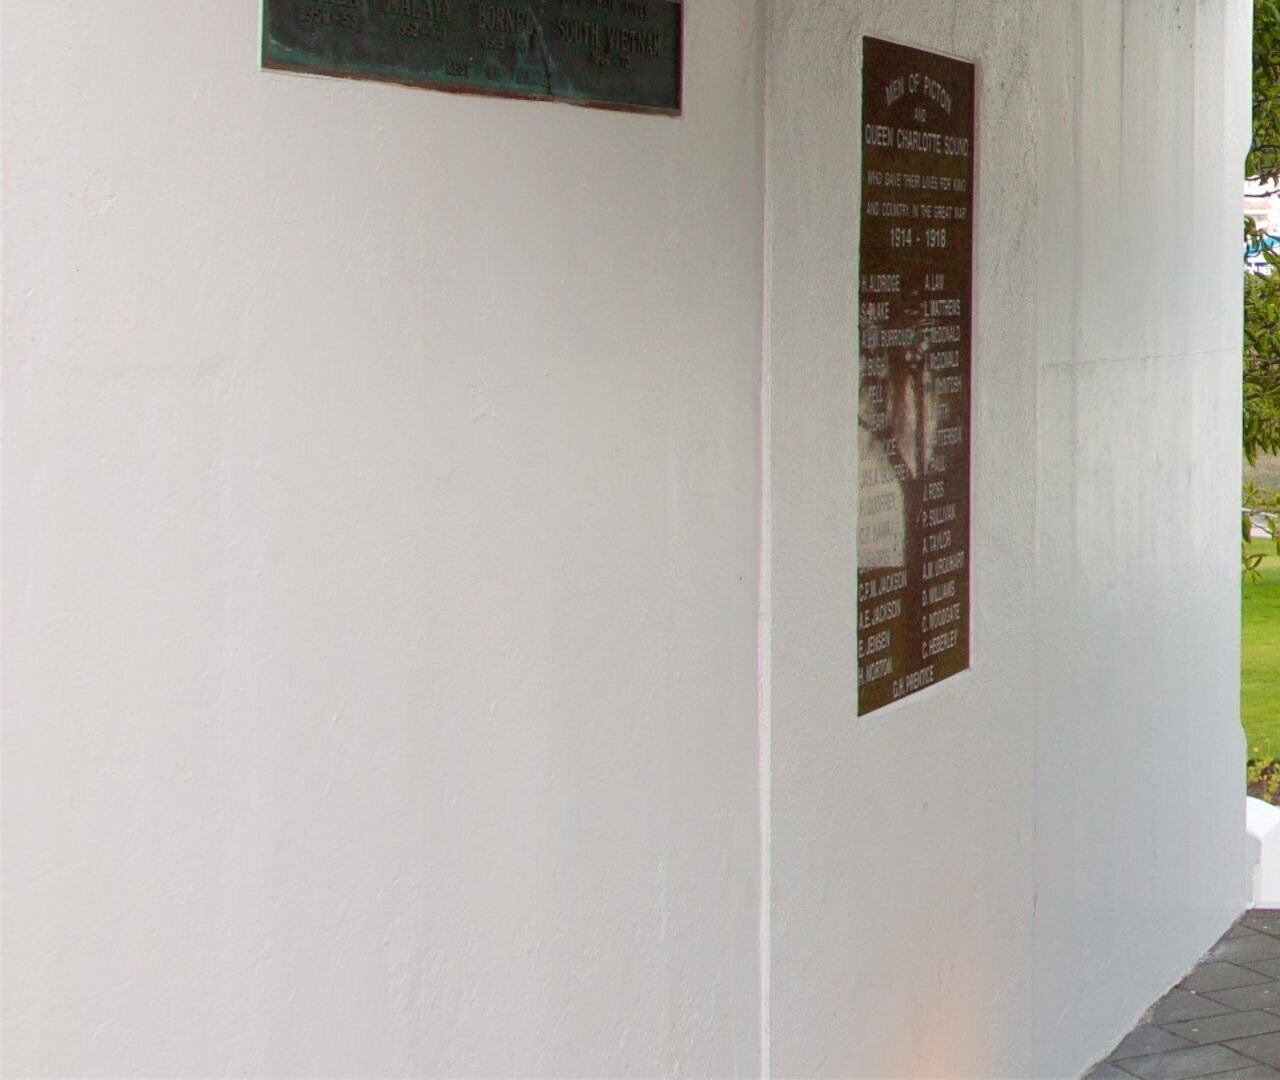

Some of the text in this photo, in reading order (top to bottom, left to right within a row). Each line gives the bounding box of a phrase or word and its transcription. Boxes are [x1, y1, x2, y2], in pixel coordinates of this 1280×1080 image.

[556, 17, 664, 58] SOUTH VIETNAM
[885, 73, 952, 116] MEN OF PICTON
[914, 107, 927, 122] AND
[865, 123, 969, 157] QUEEN CHARLOTTE SOUND
[867, 170, 966, 192] WHO GAVE THEIR LIVES FOR KING
[867, 201, 880, 216] AND
[882, 202, 909, 218] COUNTRY
[920, 204, 932, 219] THE
[934, 205, 952, 220] GREAT
[954, 206, 967, 220] WAR
[890, 227, 912, 248] 1914
[926, 228, 947, 248] 1918
